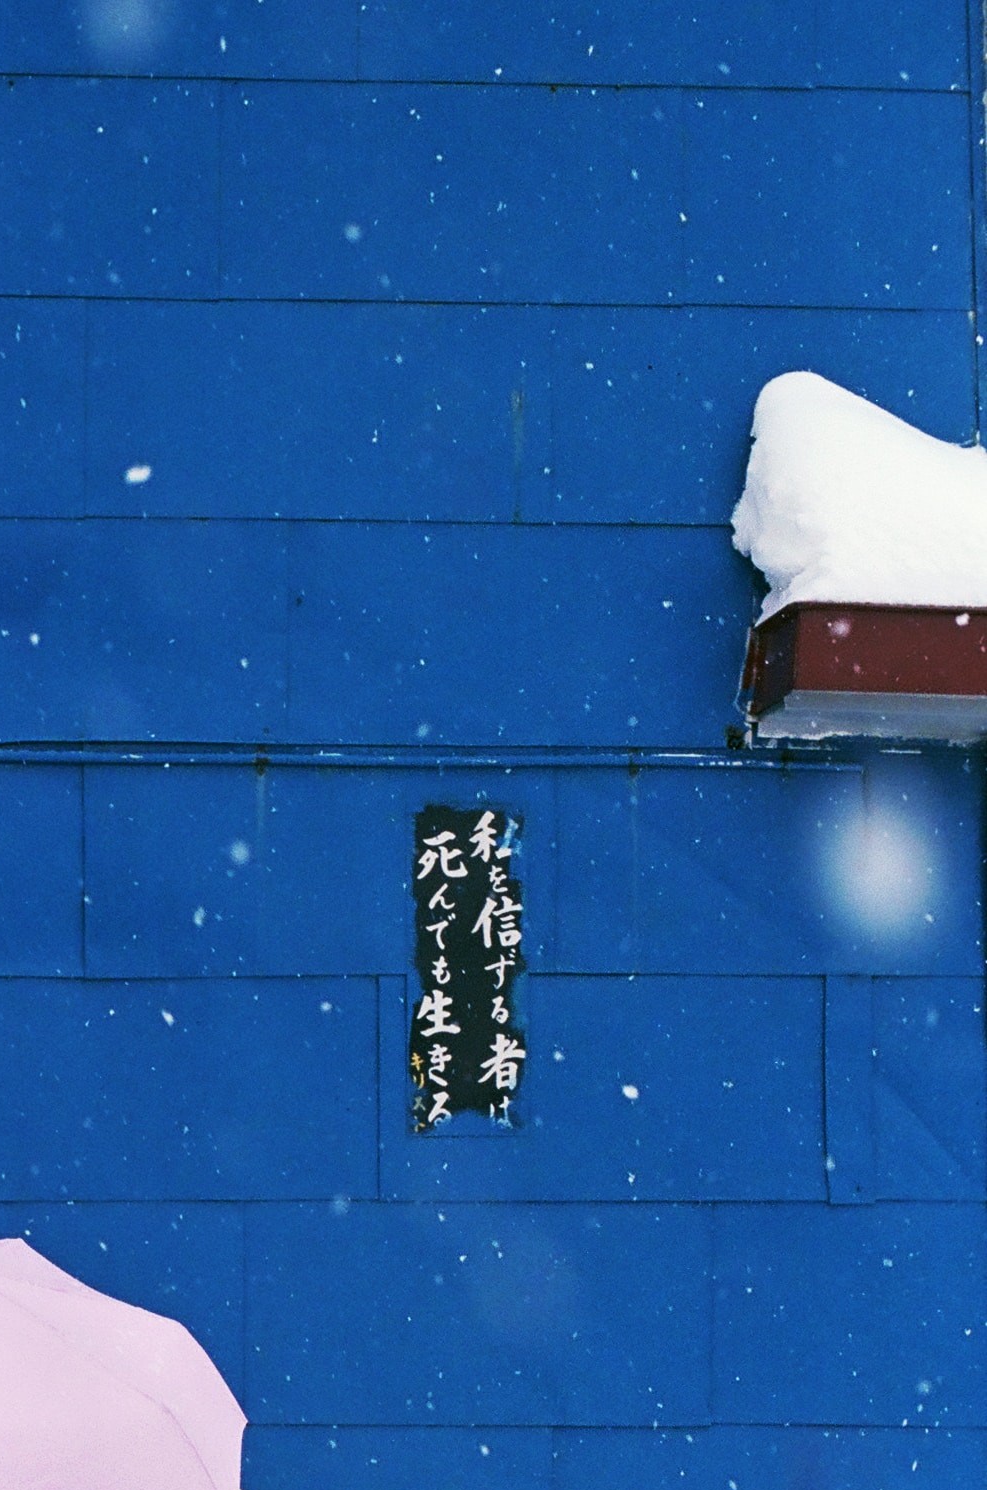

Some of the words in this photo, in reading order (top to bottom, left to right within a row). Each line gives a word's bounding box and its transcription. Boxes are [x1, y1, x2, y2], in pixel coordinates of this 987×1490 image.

[417, 830, 469, 1127] 死んでも生きる
[469, 811, 526, 1128] 私を信ずる者は
